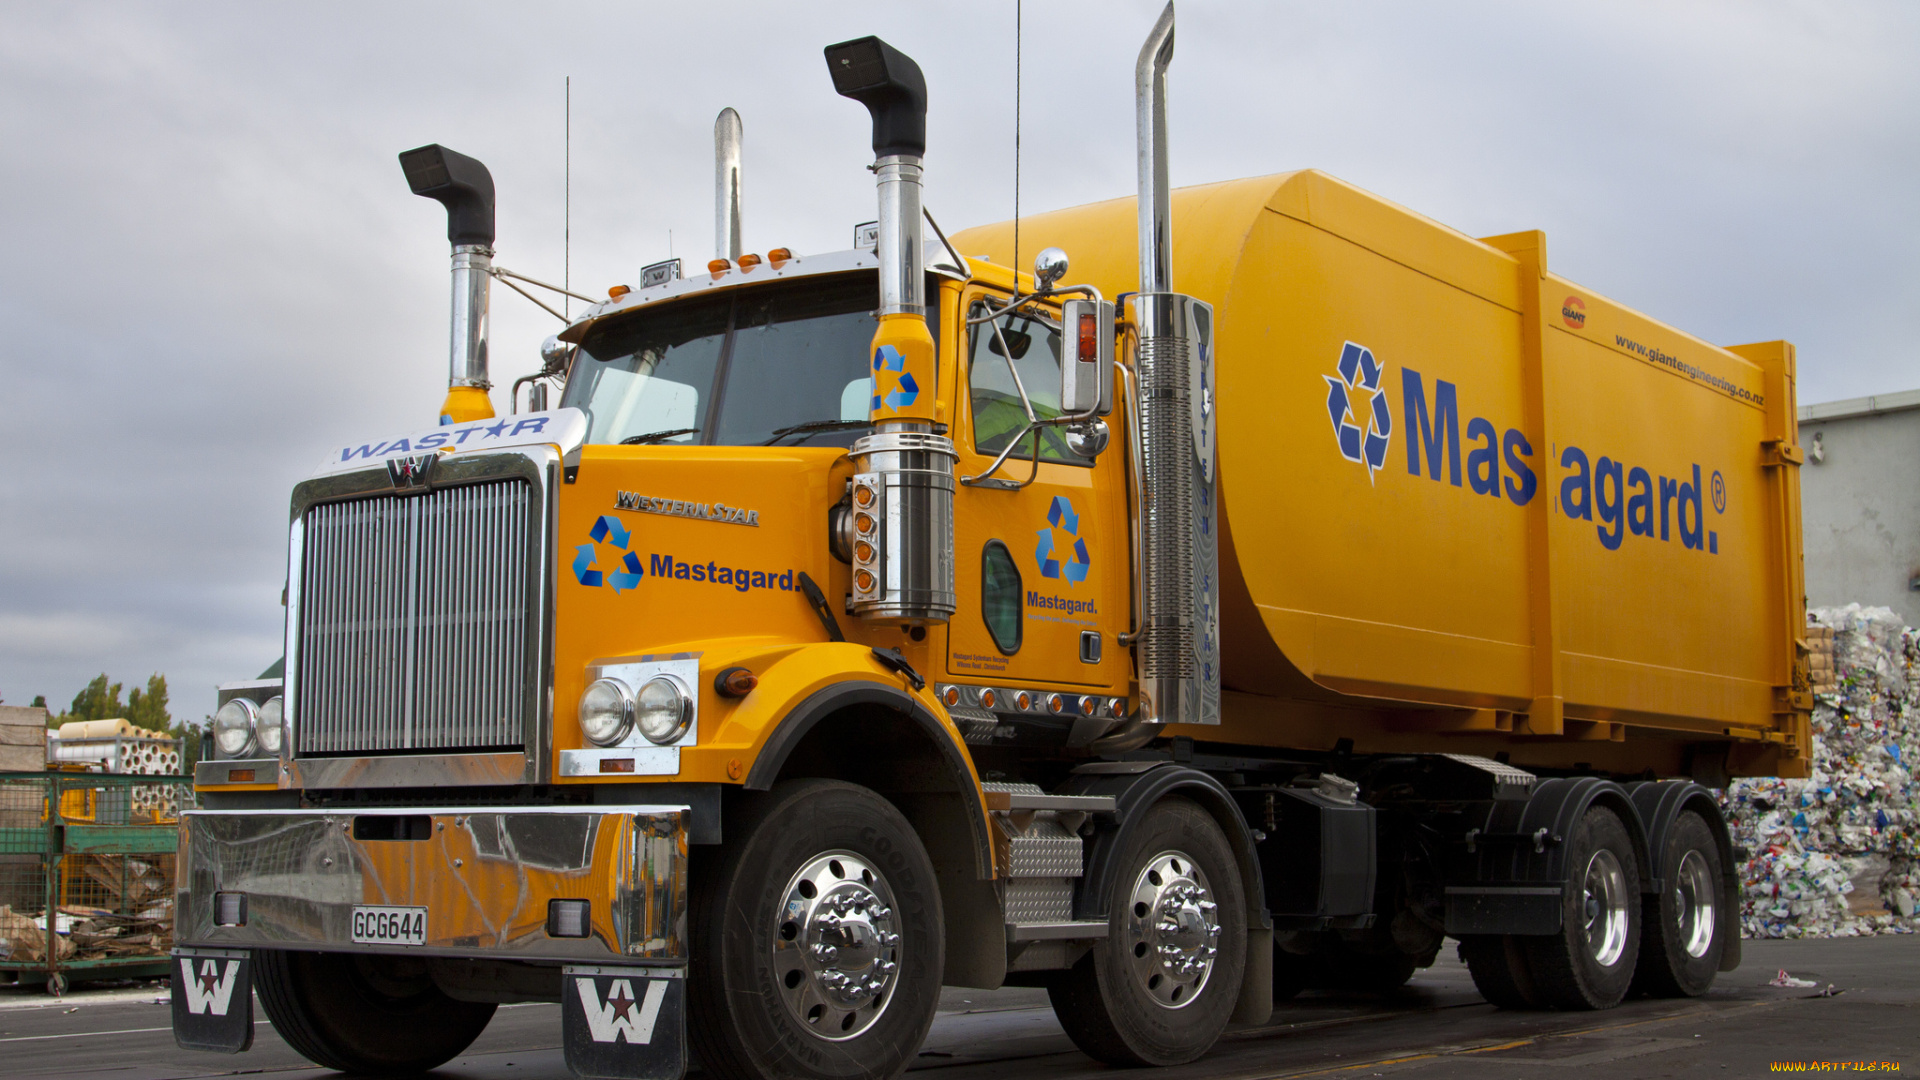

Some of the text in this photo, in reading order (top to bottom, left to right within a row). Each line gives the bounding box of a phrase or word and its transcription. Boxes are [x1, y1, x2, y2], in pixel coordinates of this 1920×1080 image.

[653, 270, 664, 280] W
[1562, 306, 1586, 324] GIANT
[1615, 334, 1764, 406] www.giantengineering.co.nz
[617, 490, 759, 526] WESTERN STAR
[650, 553, 800, 592] Mastagard.
[1027, 590, 1098, 615] Mastagard.
[354, 911, 423, 940] GCG644
